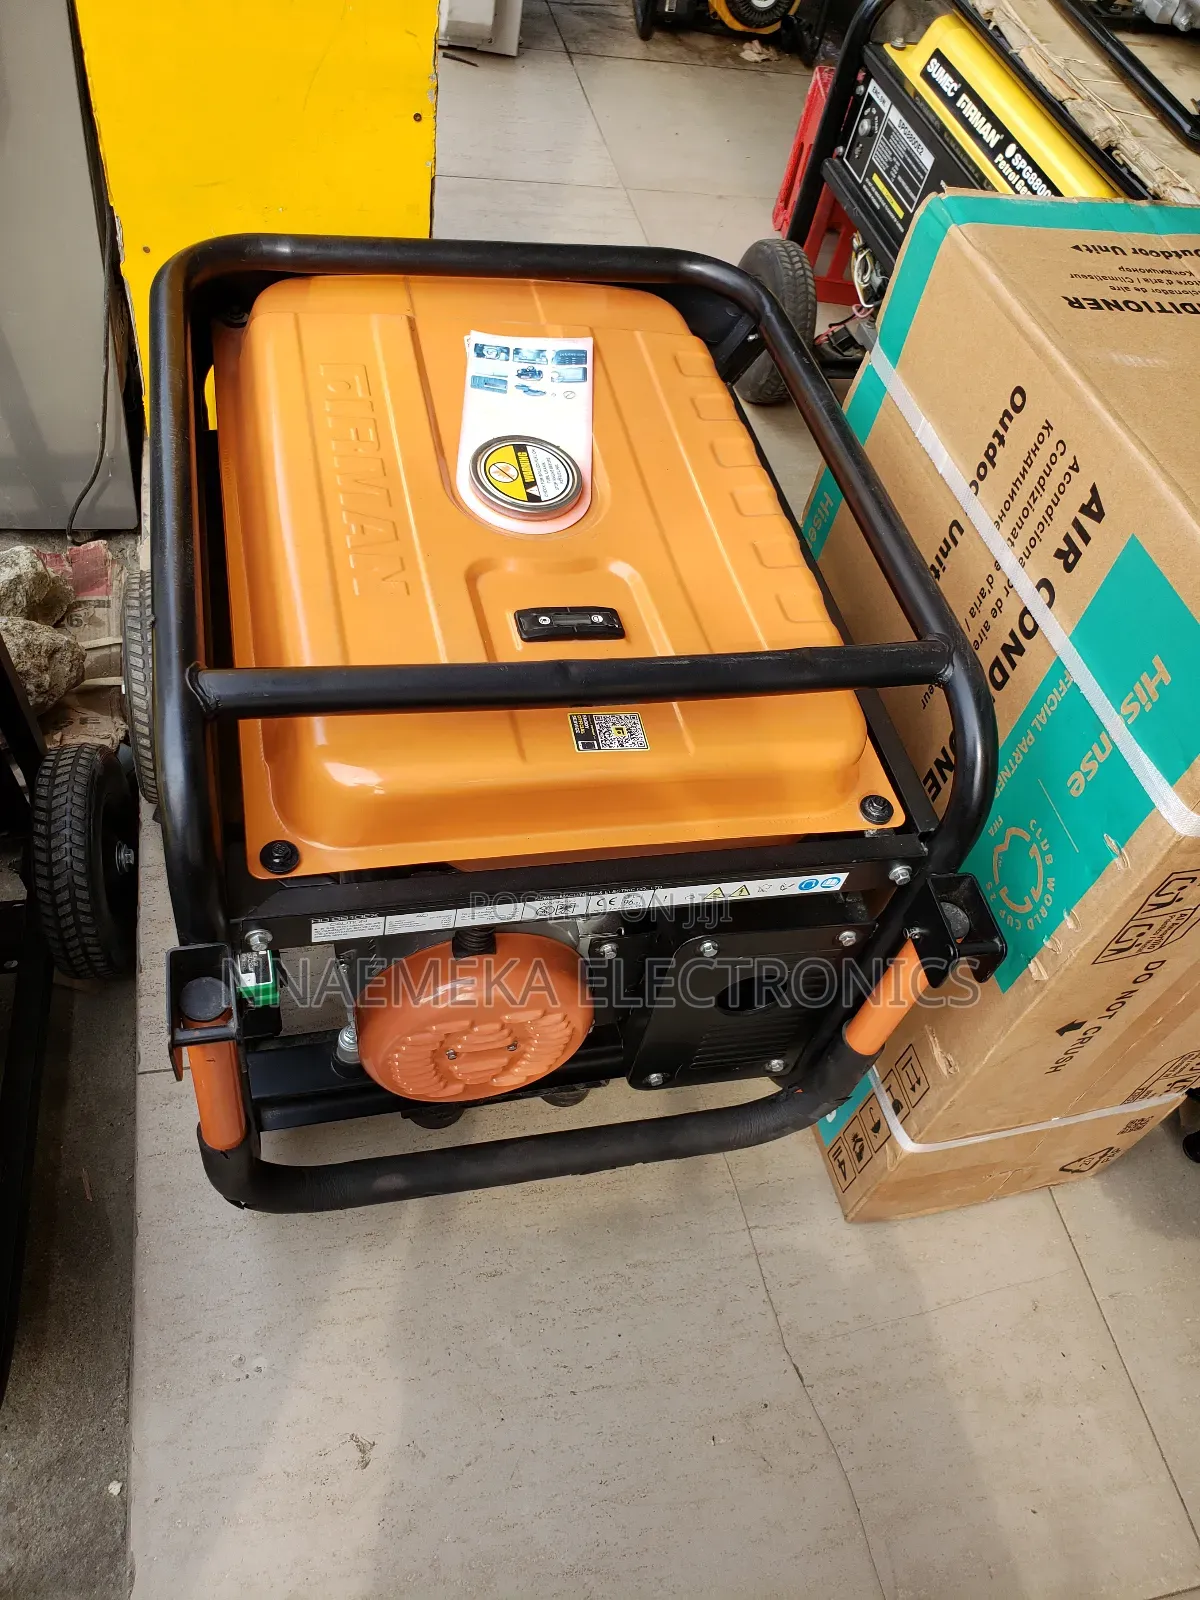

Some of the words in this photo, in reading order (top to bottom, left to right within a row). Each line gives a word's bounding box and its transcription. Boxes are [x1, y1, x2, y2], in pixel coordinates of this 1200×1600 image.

[926, 58, 959, 97] SUMEC
[955, 93, 1003, 149] FIRMAN
[993, 153, 1020, 185] Petrol
[1069, 273, 1135, 285] Climatiseur
[1118, 265, 1195, 277] Кондиционер
[1108, 284, 1132, 293] aire
[1133, 285, 1148, 294] de
[1060, 295, 1200, 315] DITIONER
[319, 362, 411, 597] FIRMAN
[517, 451, 535, 483] WARNING
[1052, 481, 1106, 574] AIR
[968, 573, 995, 620] d'aria
[989, 600, 1004, 620] de
[972, 619, 991, 652] aire
[1066, 654, 1172, 798] Hisnse
[988, 815, 1004, 837] FIFA
[1029, 819, 1054, 866] CLUB
[999, 908, 1022, 931] CUP
[1026, 877, 1056, 931] WORLD
[1131, 959, 1167, 985] DO
[1097, 988, 1140, 1021] NOT
[1044, 1025, 1103, 1076] CRUSH
